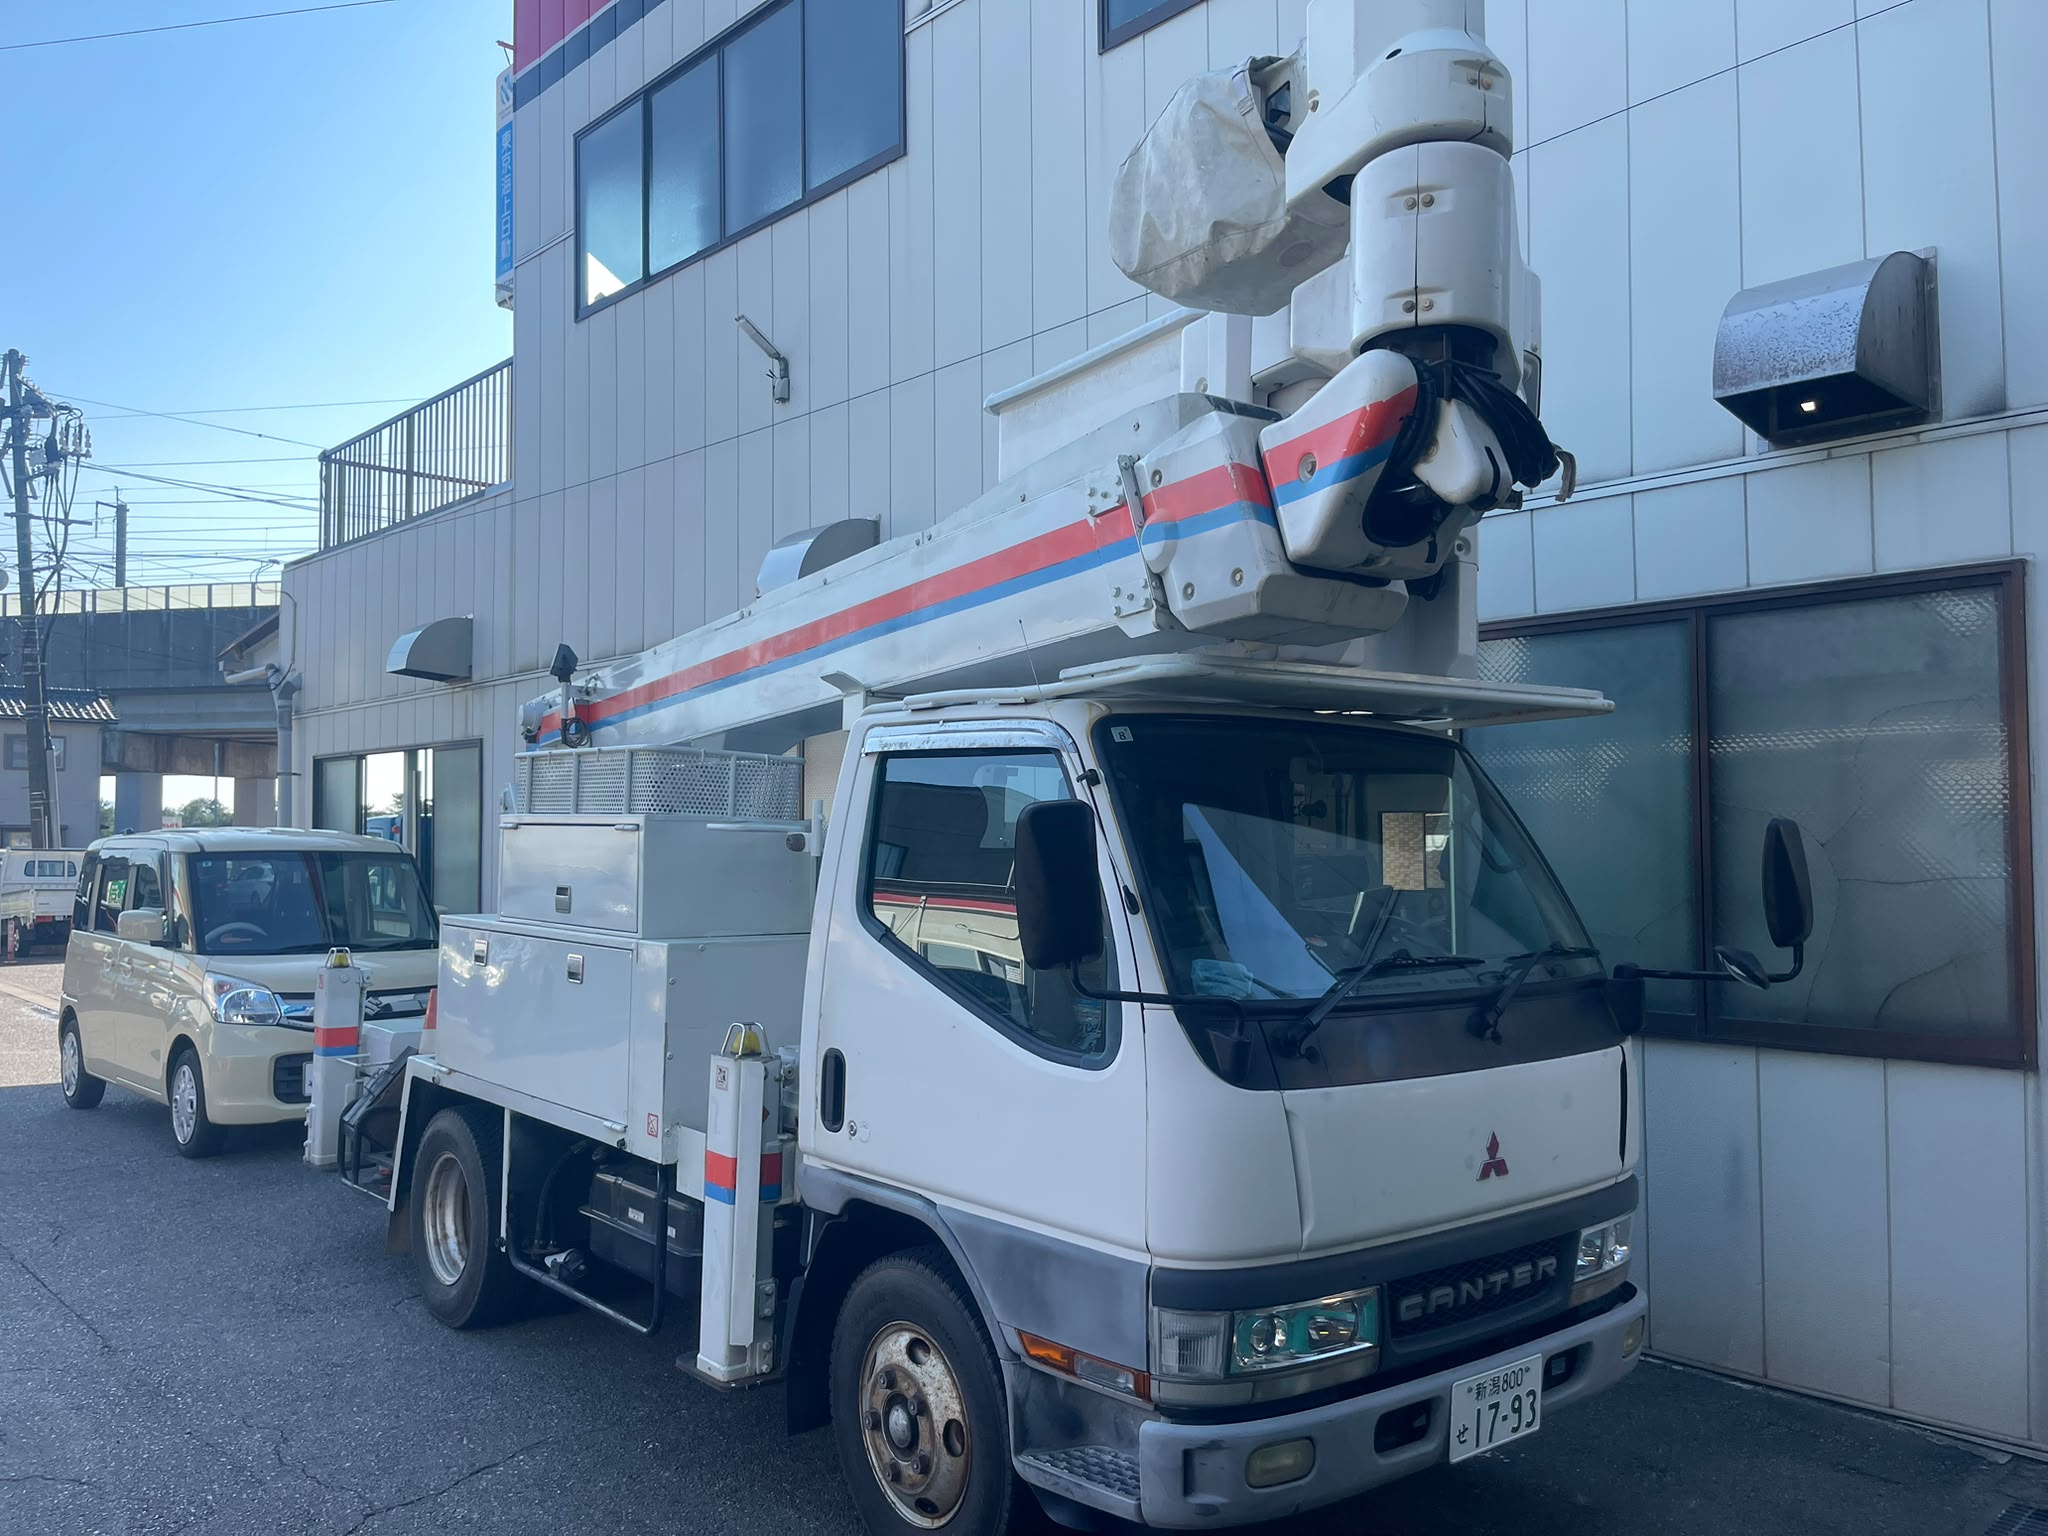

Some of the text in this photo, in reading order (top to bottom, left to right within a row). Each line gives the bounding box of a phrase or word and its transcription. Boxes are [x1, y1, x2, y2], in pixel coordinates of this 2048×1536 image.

[1399, 1255, 1558, 1321] CANTER
[1456, 1388, 1537, 1449] せ 17-93
